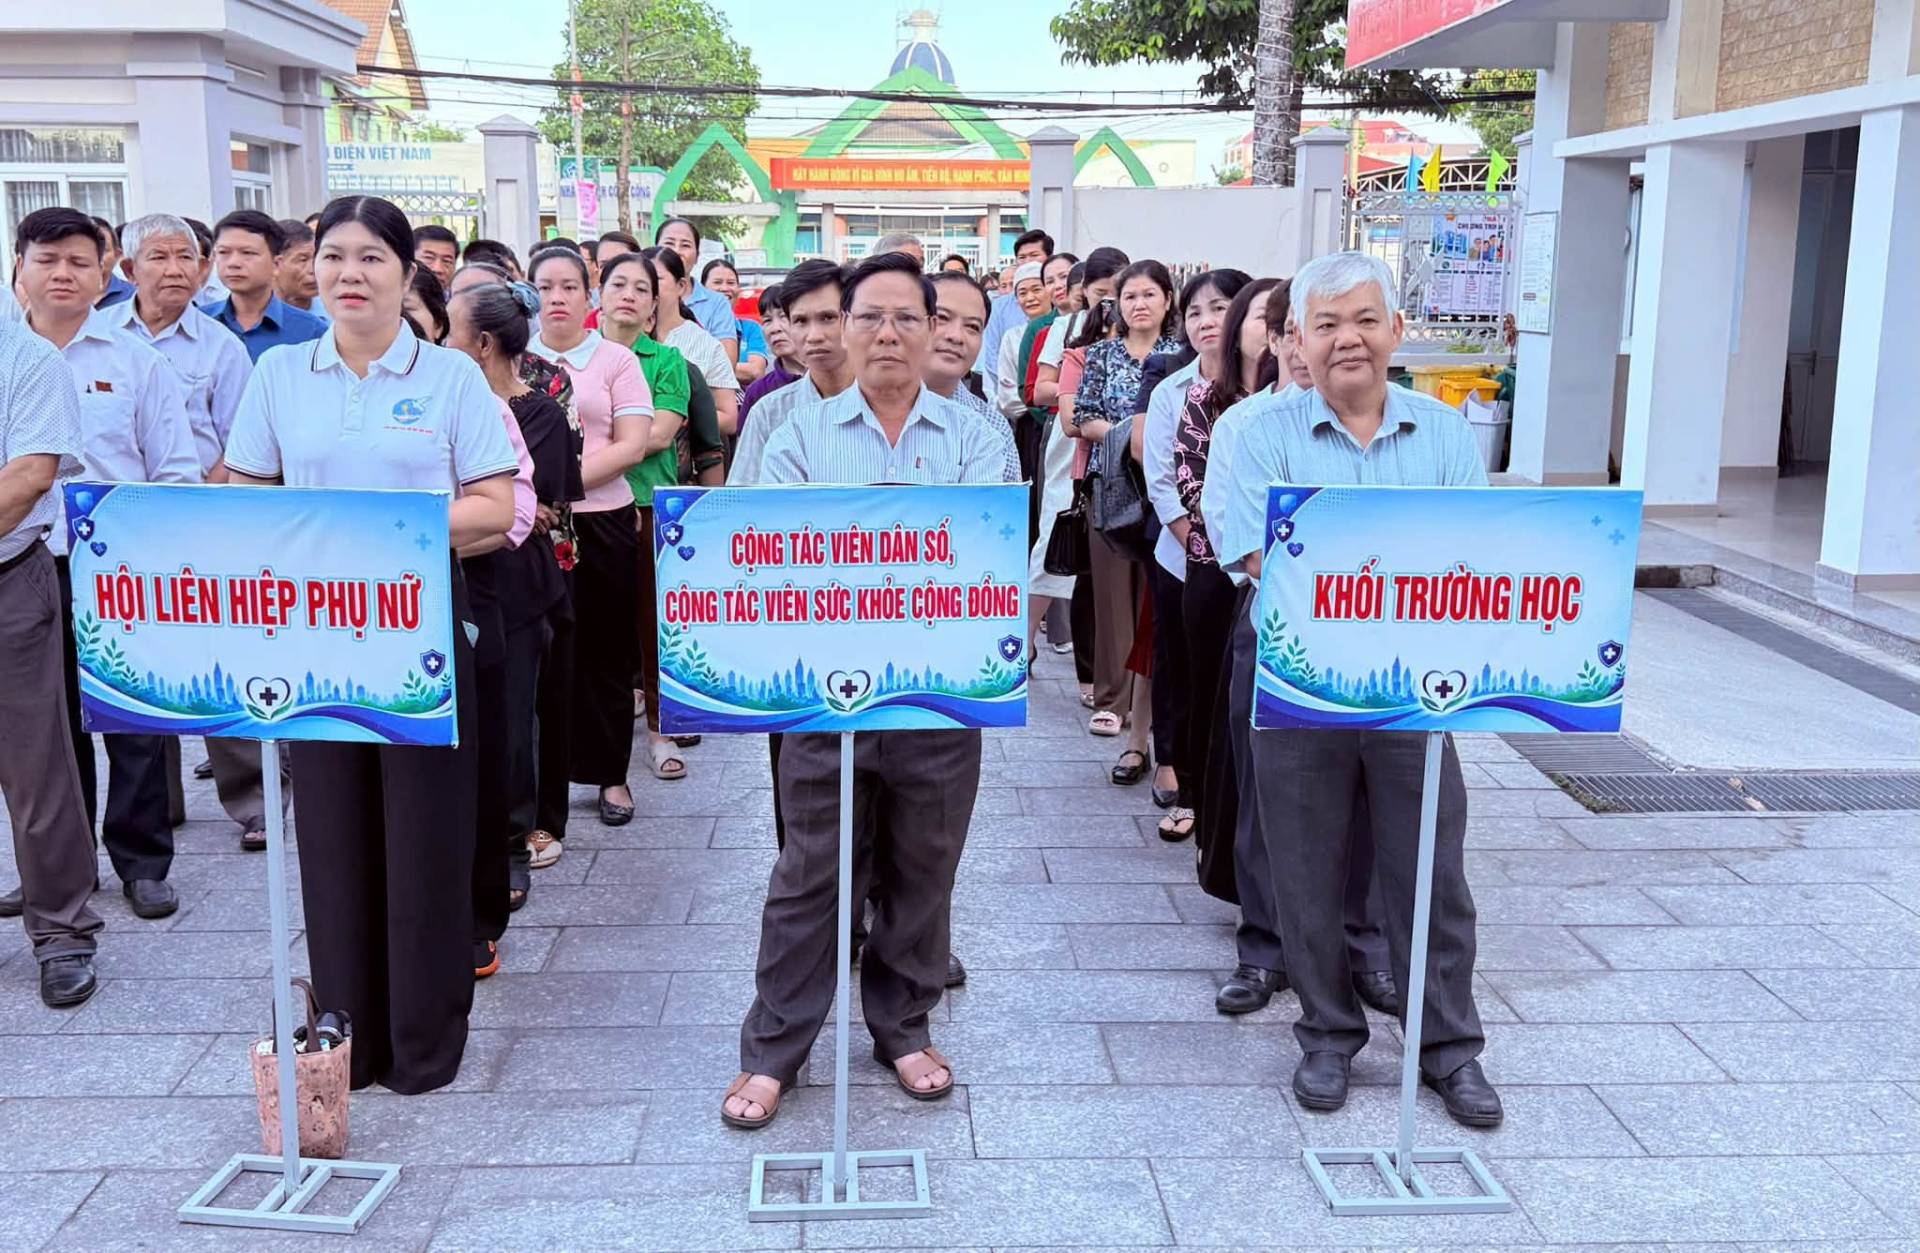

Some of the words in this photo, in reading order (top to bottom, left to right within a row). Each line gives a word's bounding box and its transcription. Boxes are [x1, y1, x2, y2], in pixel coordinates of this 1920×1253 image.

[370, 145, 397, 162] VIỆT
[401, 147, 432, 160] NAM
[730, 526, 784, 573] CỘNG
[789, 525, 825, 566] TÁC
[830, 524, 874, 564] VIÊN
[879, 523, 919, 563] DÂN
[924, 517, 955, 566] SỐ,
[94, 563, 146, 632] HỘI
[153, 566, 221, 625] LIÊN
[228, 568, 298, 636] HIỆP
[306, 579, 367, 638] PHỤ
[376, 572, 423, 630] NỮ
[664, 584, 719, 630] CỘNG
[723, 582, 760, 624] TÁC
[764, 582, 809, 623] VIÊN
[813, 581, 852, 622] SỨC
[857, 575, 906, 621] KHỎE
[911, 580, 962, 628] CỘNG
[967, 573, 1020, 619] ĐỒNG
[1313, 558, 1385, 620] KHỐI
[1393, 562, 1511, 621] TRƯỜNG
[1519, 575, 1583, 632] HỌC
